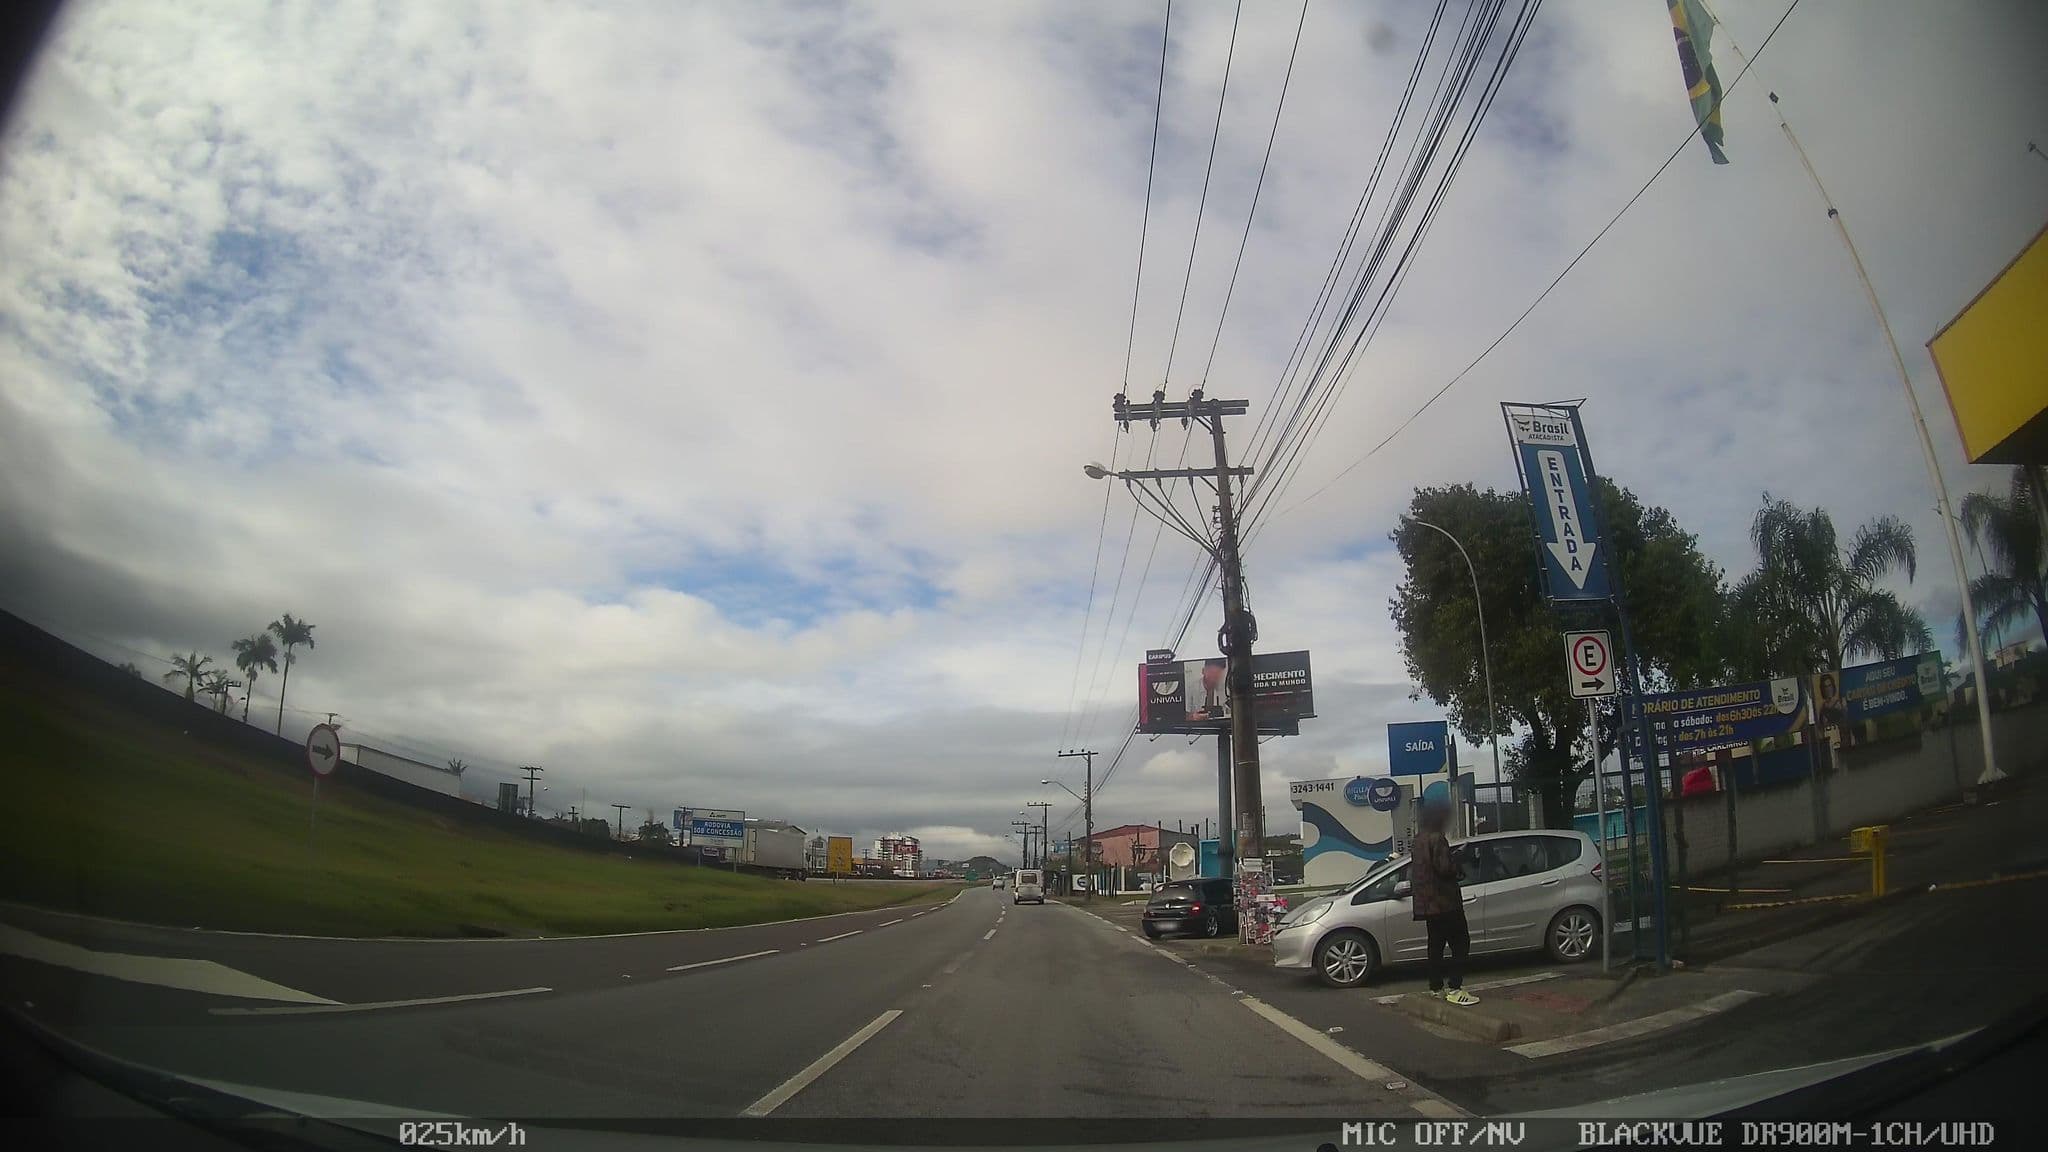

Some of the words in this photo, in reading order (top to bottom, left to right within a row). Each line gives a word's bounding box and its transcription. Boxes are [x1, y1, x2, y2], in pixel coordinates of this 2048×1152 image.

[1532, 420, 1569, 435] Brasil
[1528, 433, 1565, 442] ATACADISTA
[1546, 456, 1583, 572] ENTRADA
[1583, 645, 1597, 667] E
[1253, 669, 1306, 682] HECIMENTO
[1254, 680, 1270, 689] UDA
[1278, 678, 1307, 687] MUNDO
[1150, 695, 1182, 705] UNIVALI
[1681, 697, 1695, 710] DE
[1695, 688, 1761, 708] ATENDIMENTO
[1680, 714, 1713, 728] sábado:
[1729, 708, 1751, 721] 6h30
[1694, 726, 1706, 740] 7h
[1718, 724, 1734, 736] 21h
[1405, 739, 1435, 752] SAÍDA
[704, 821, 732, 830] RODOVIA
[706, 828, 743, 837] CONCESSÃO
